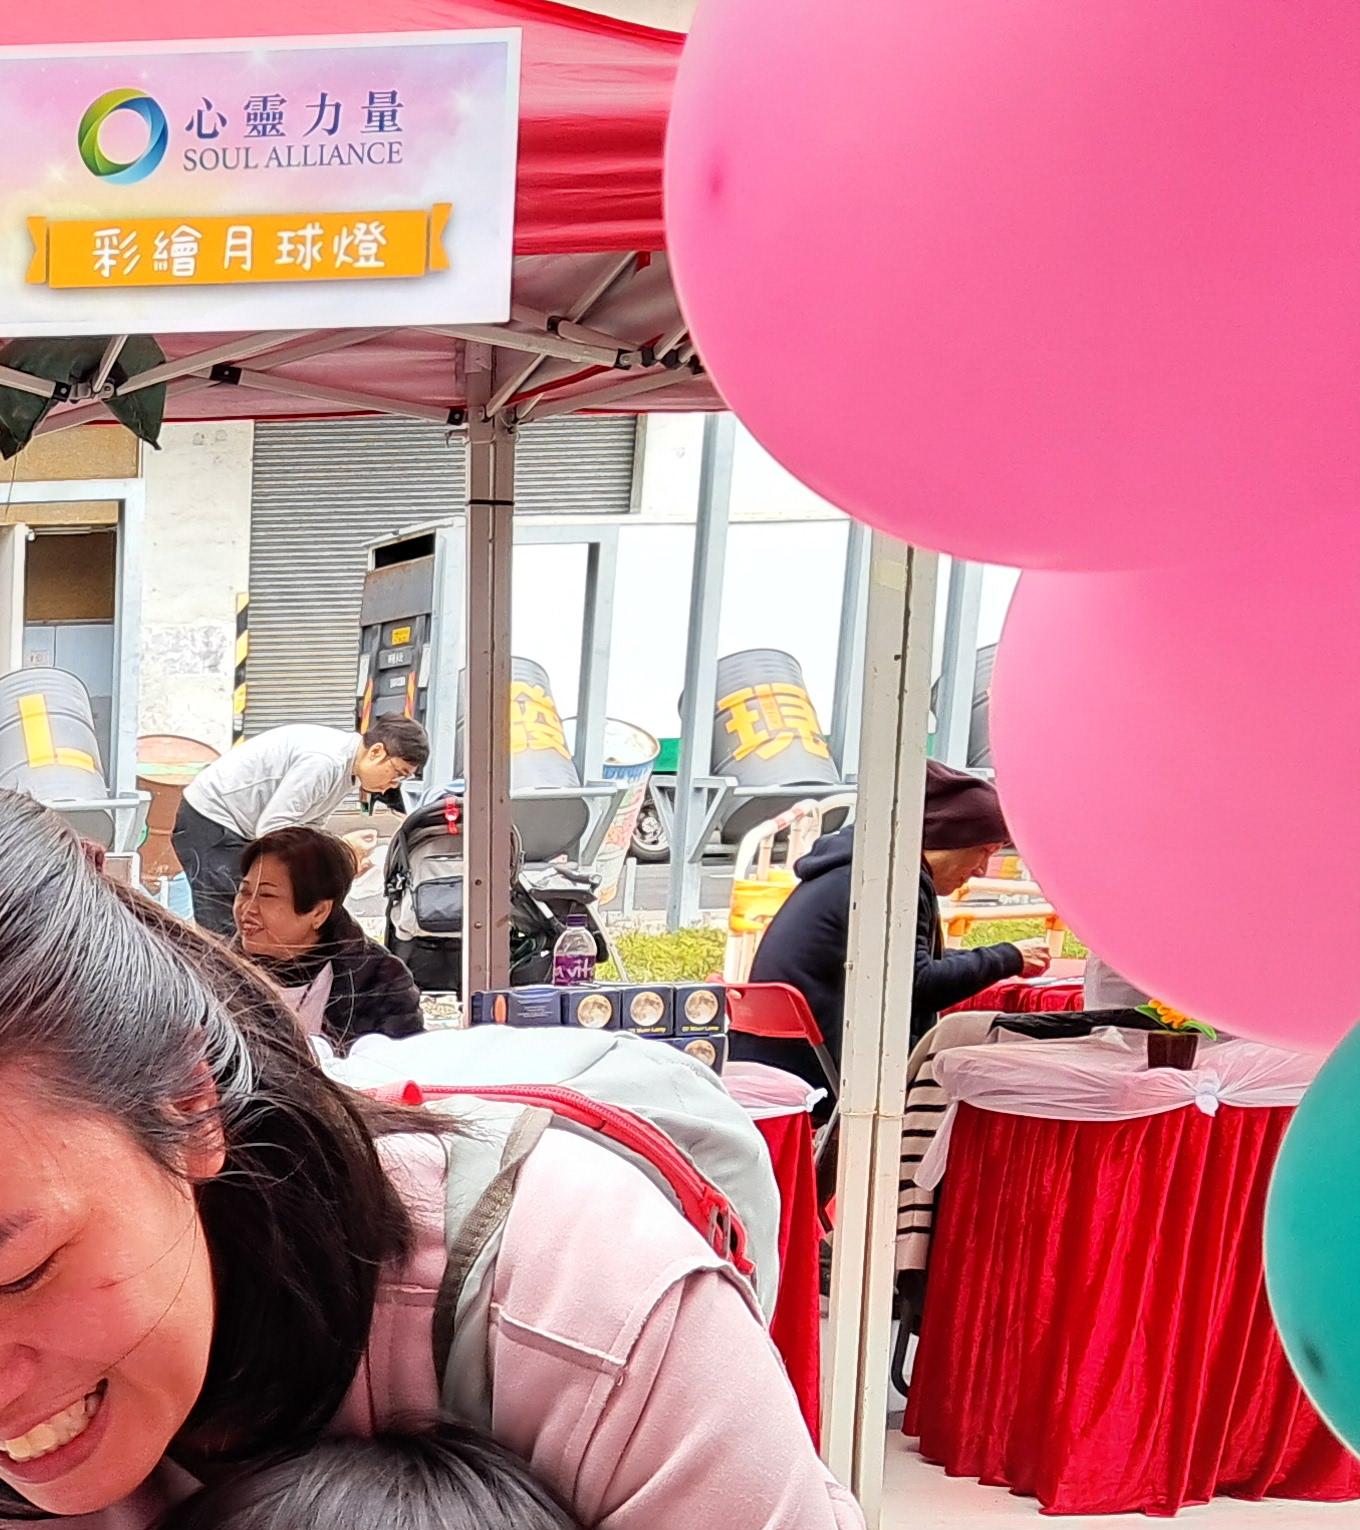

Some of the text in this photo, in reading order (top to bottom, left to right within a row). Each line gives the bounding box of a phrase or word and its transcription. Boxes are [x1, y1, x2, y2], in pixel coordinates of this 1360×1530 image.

[185, 89, 404, 139] 心靈力量
[183, 141, 404, 172] SOUL ALLIANCE
[92, 221, 387, 278] 彩繪月球燈
[717, 682, 830, 761] 現
